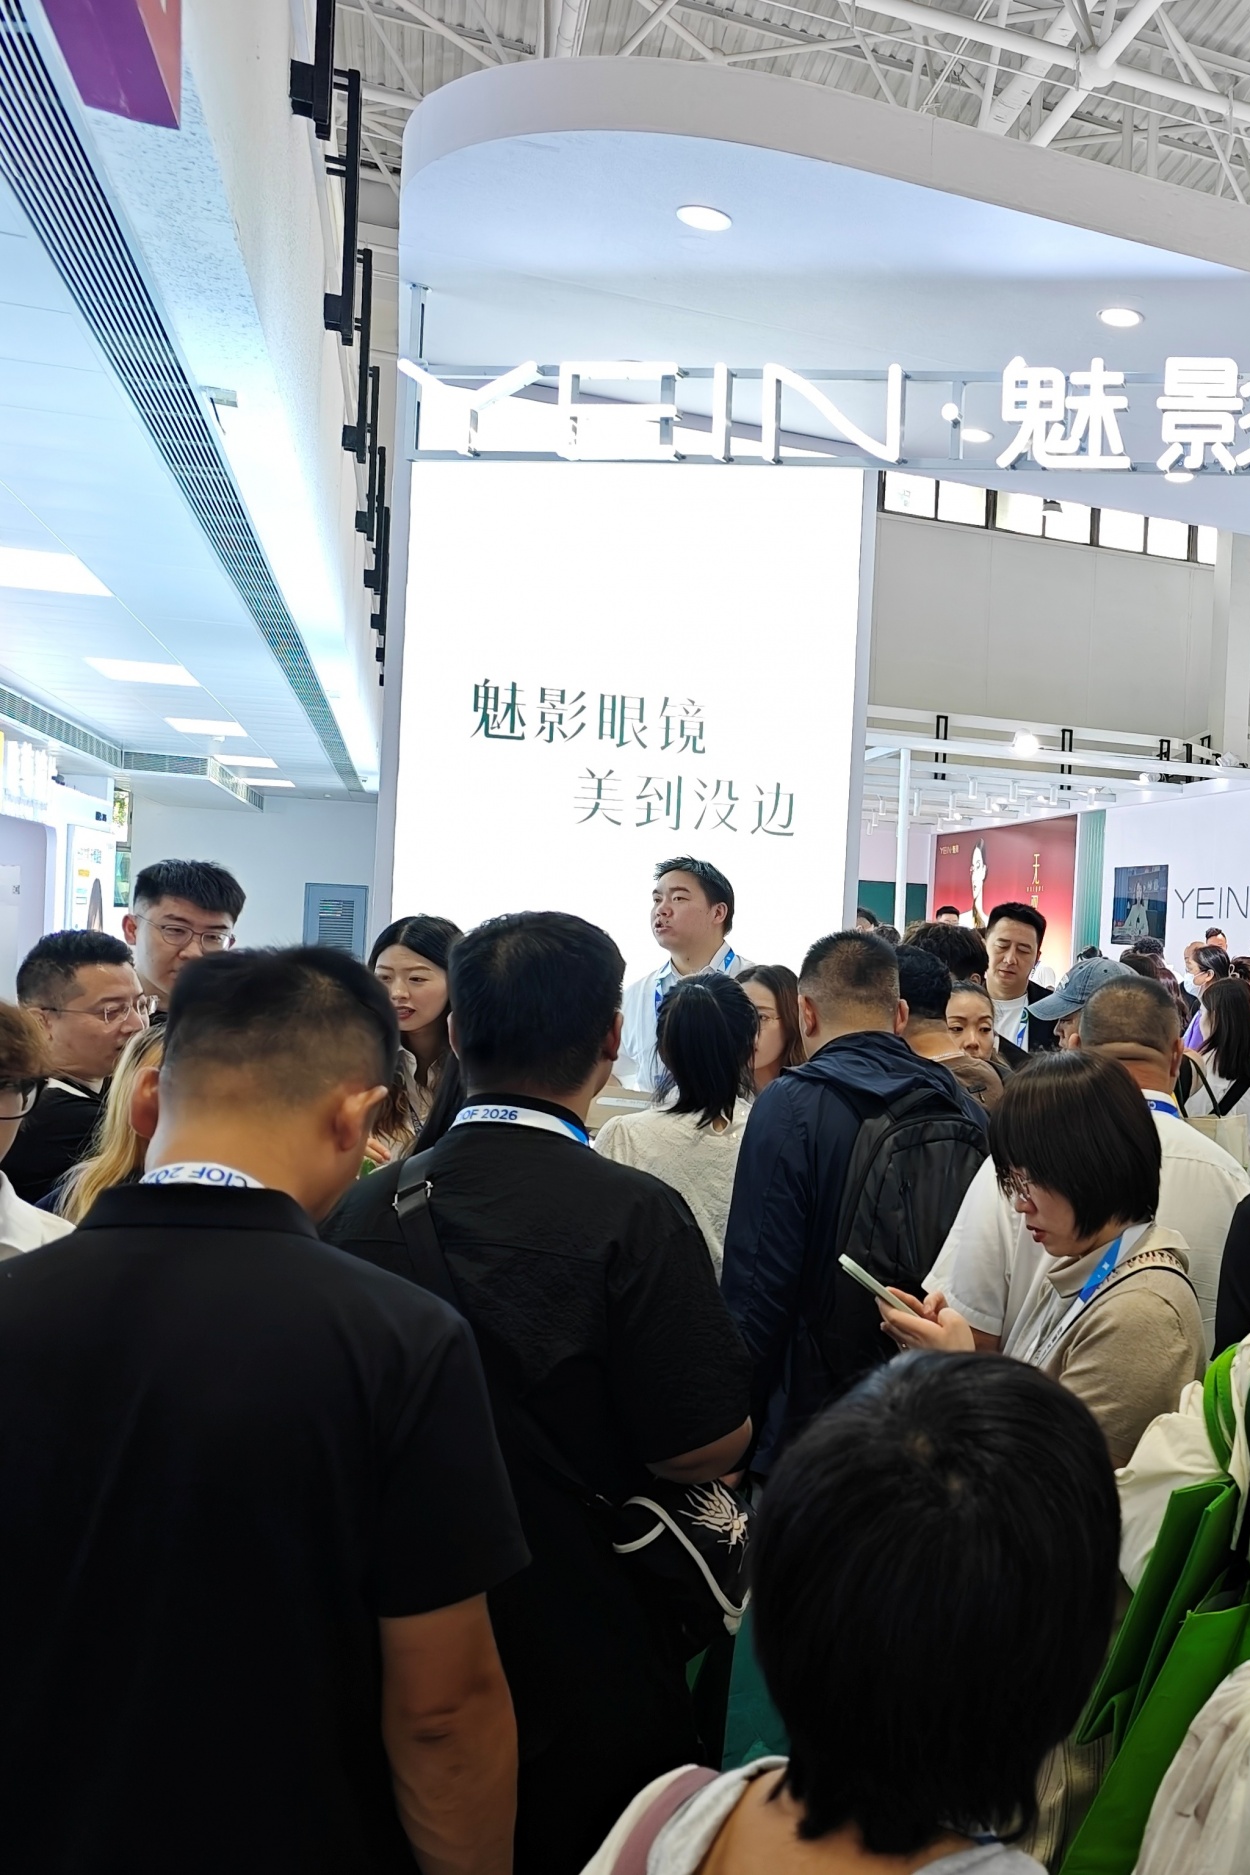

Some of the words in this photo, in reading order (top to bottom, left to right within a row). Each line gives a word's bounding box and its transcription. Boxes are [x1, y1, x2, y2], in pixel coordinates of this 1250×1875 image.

[470, 677, 706, 755] 魅影眼镜
[573, 767, 795, 837] 美到没边
[481, 1108, 518, 1121] 2026
